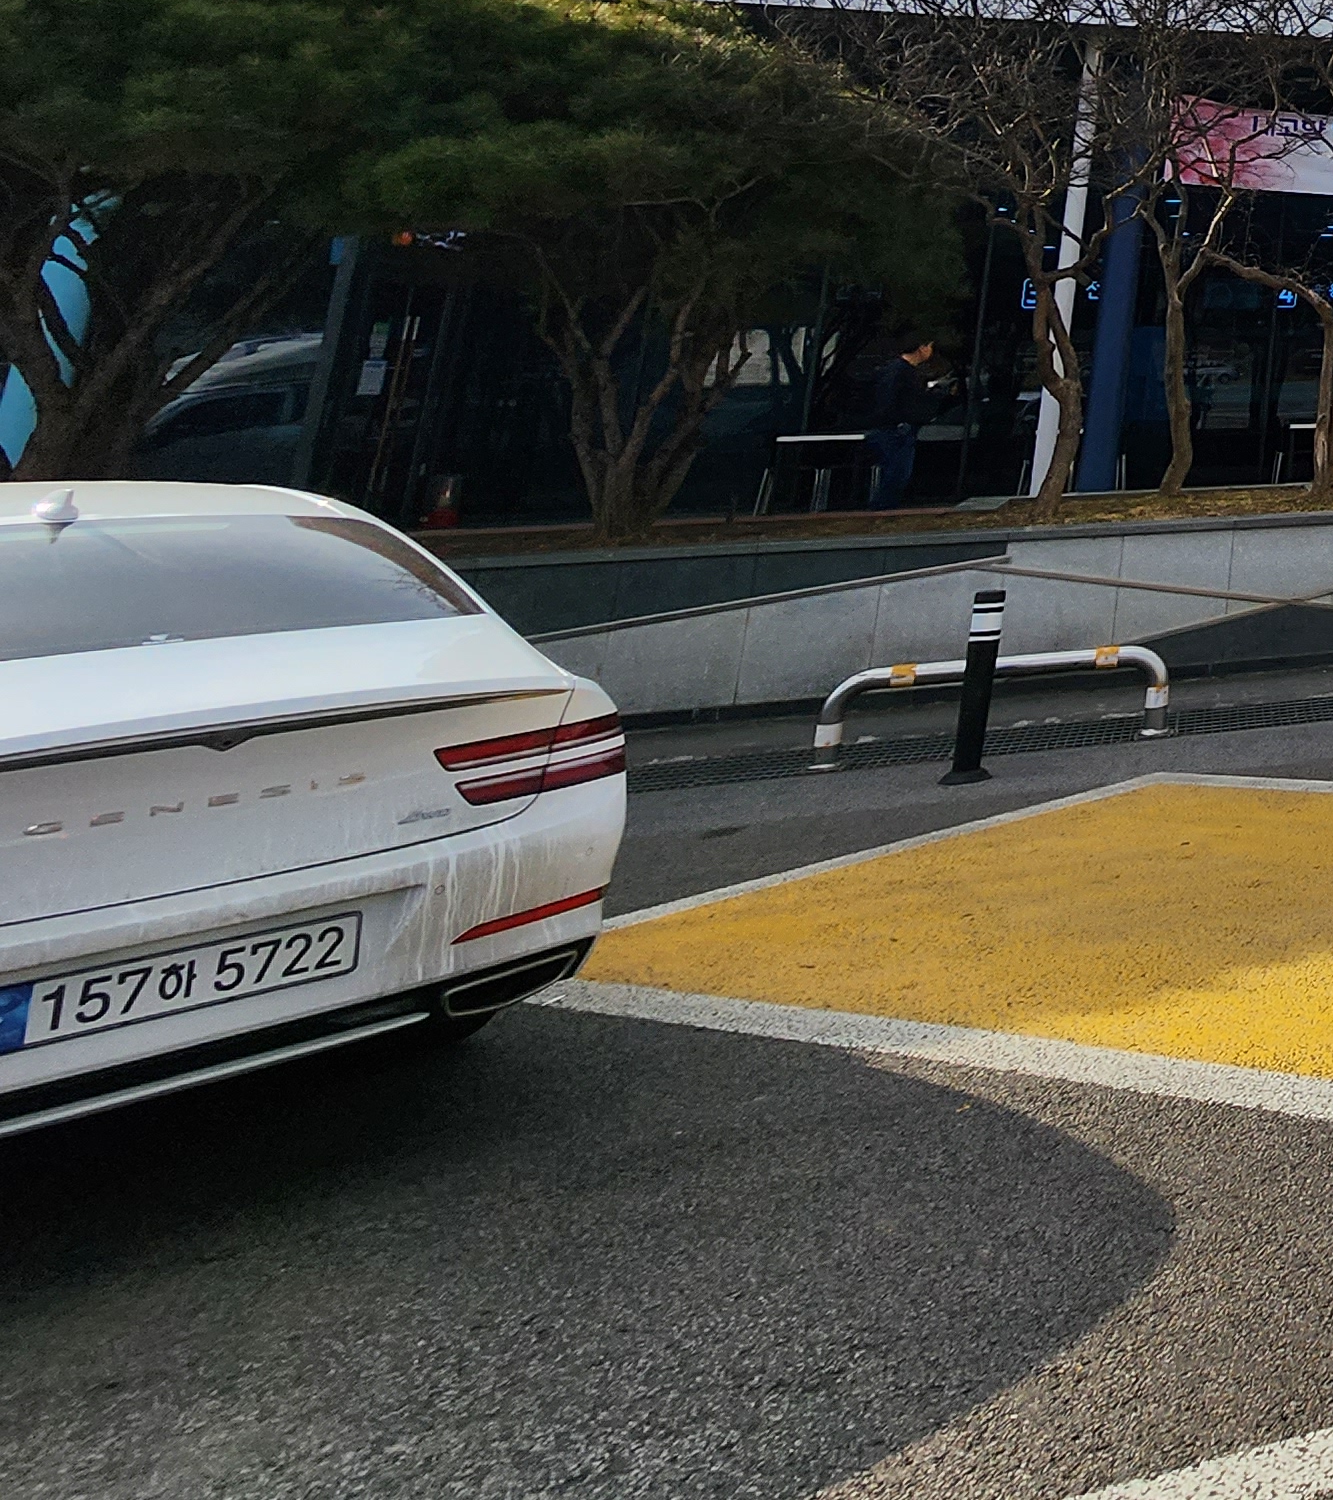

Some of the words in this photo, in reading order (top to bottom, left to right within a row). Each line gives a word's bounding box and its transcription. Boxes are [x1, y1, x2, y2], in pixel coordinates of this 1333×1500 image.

[23, 771, 367, 835] GENESIS
[41, 959, 197, 1031] 157하
[213, 925, 345, 992] 5722
